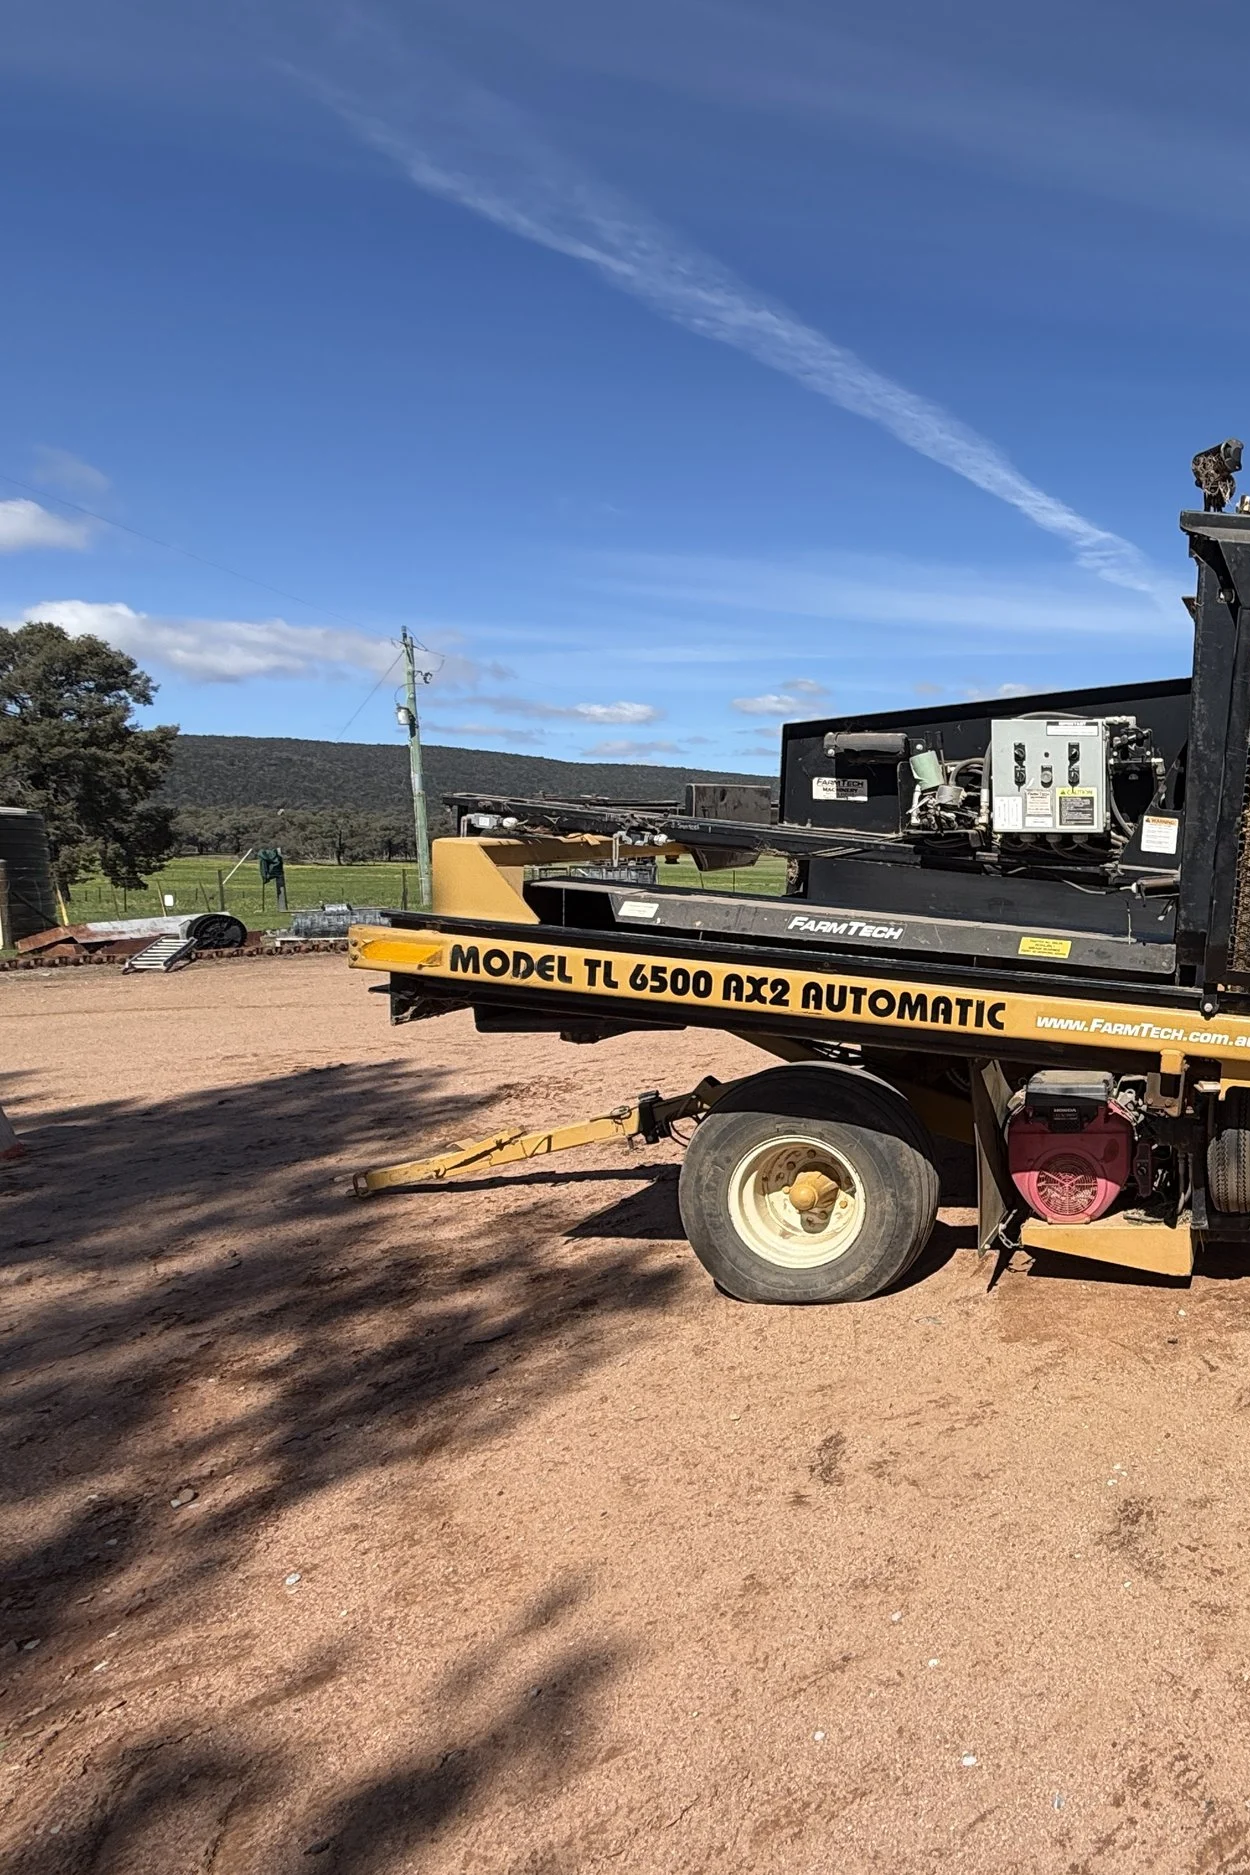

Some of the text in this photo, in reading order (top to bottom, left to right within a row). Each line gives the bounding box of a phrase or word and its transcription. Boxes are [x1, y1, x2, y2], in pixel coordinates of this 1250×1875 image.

[787, 916, 904, 940] FARMTECH
[450, 944, 1006, 1030] MODEL TL 6500 AX2 AUTOMATIC
